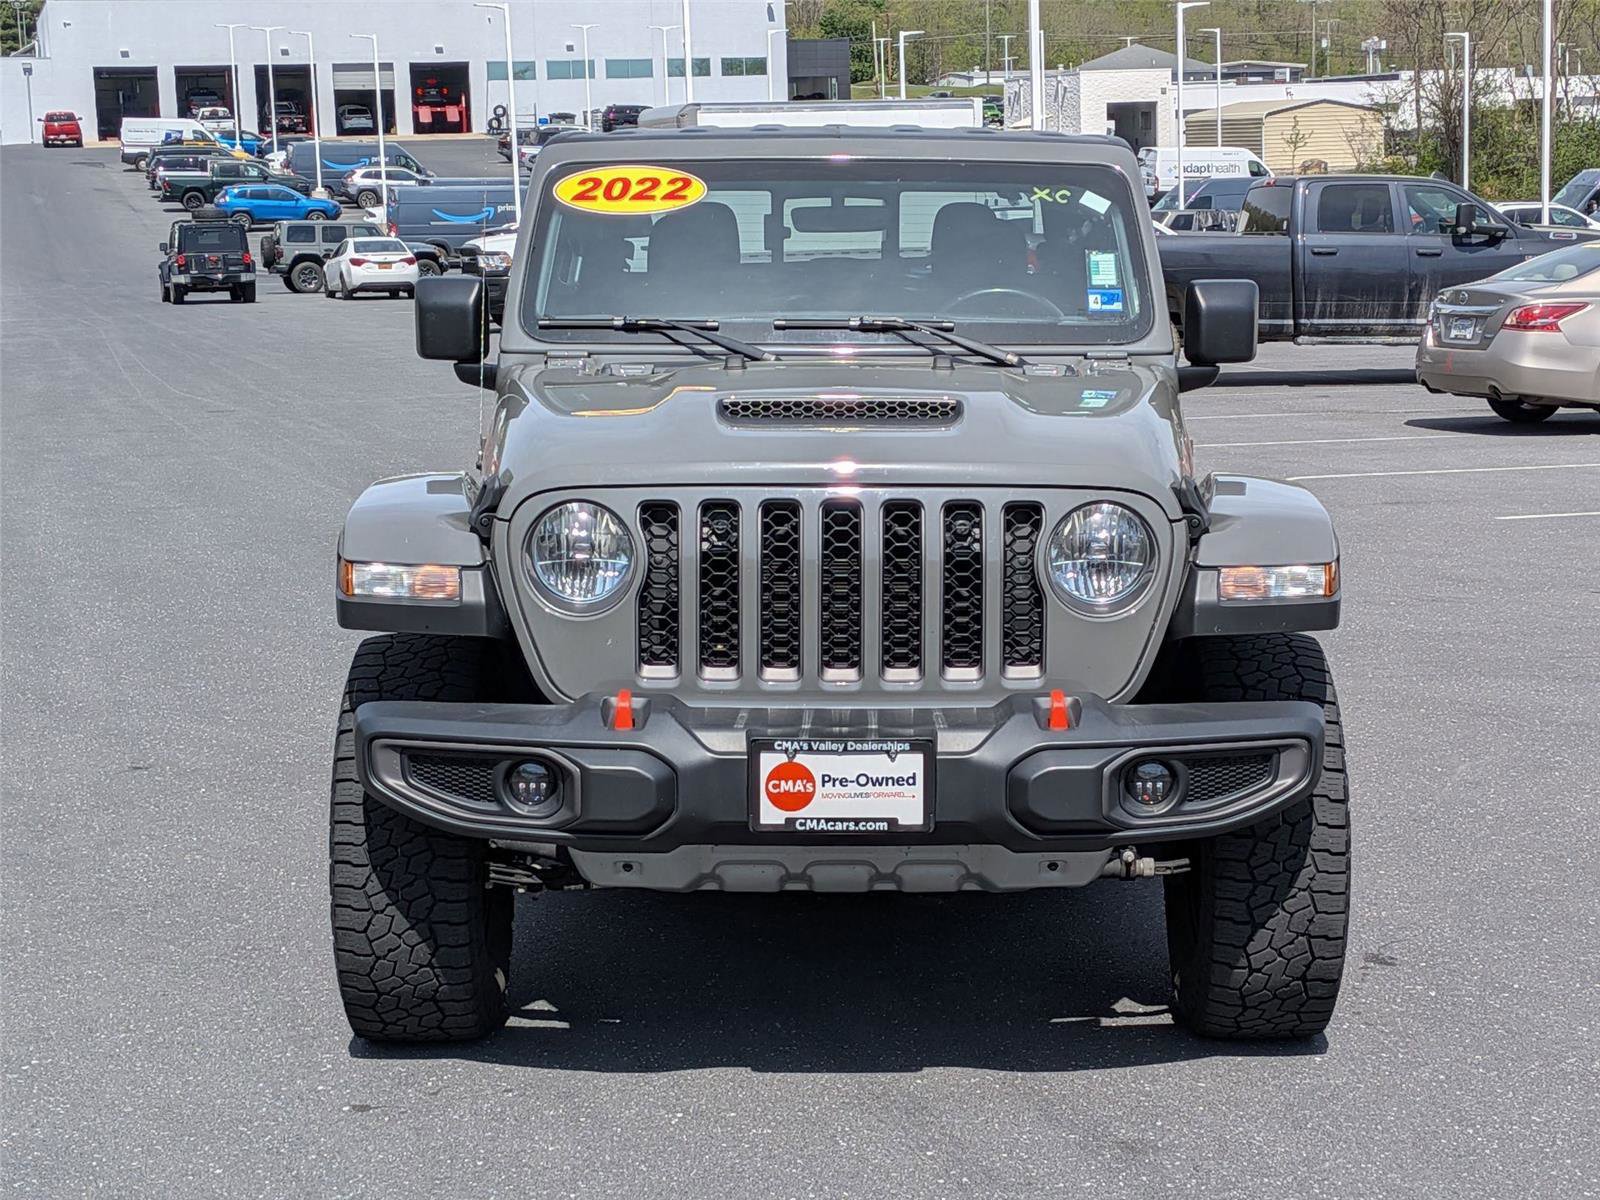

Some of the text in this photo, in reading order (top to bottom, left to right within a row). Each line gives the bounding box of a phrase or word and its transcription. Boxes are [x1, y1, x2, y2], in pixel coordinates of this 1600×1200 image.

[571, 177, 693, 202] 2022
[497, 203, 517, 213] prim
[774, 741, 910, 752] CMA's Valley Dealerships
[821, 772, 917, 788] Pre-Owned
[767, 780, 814, 793] CMA's
[795, 819, 888, 831] CMAcars.com
